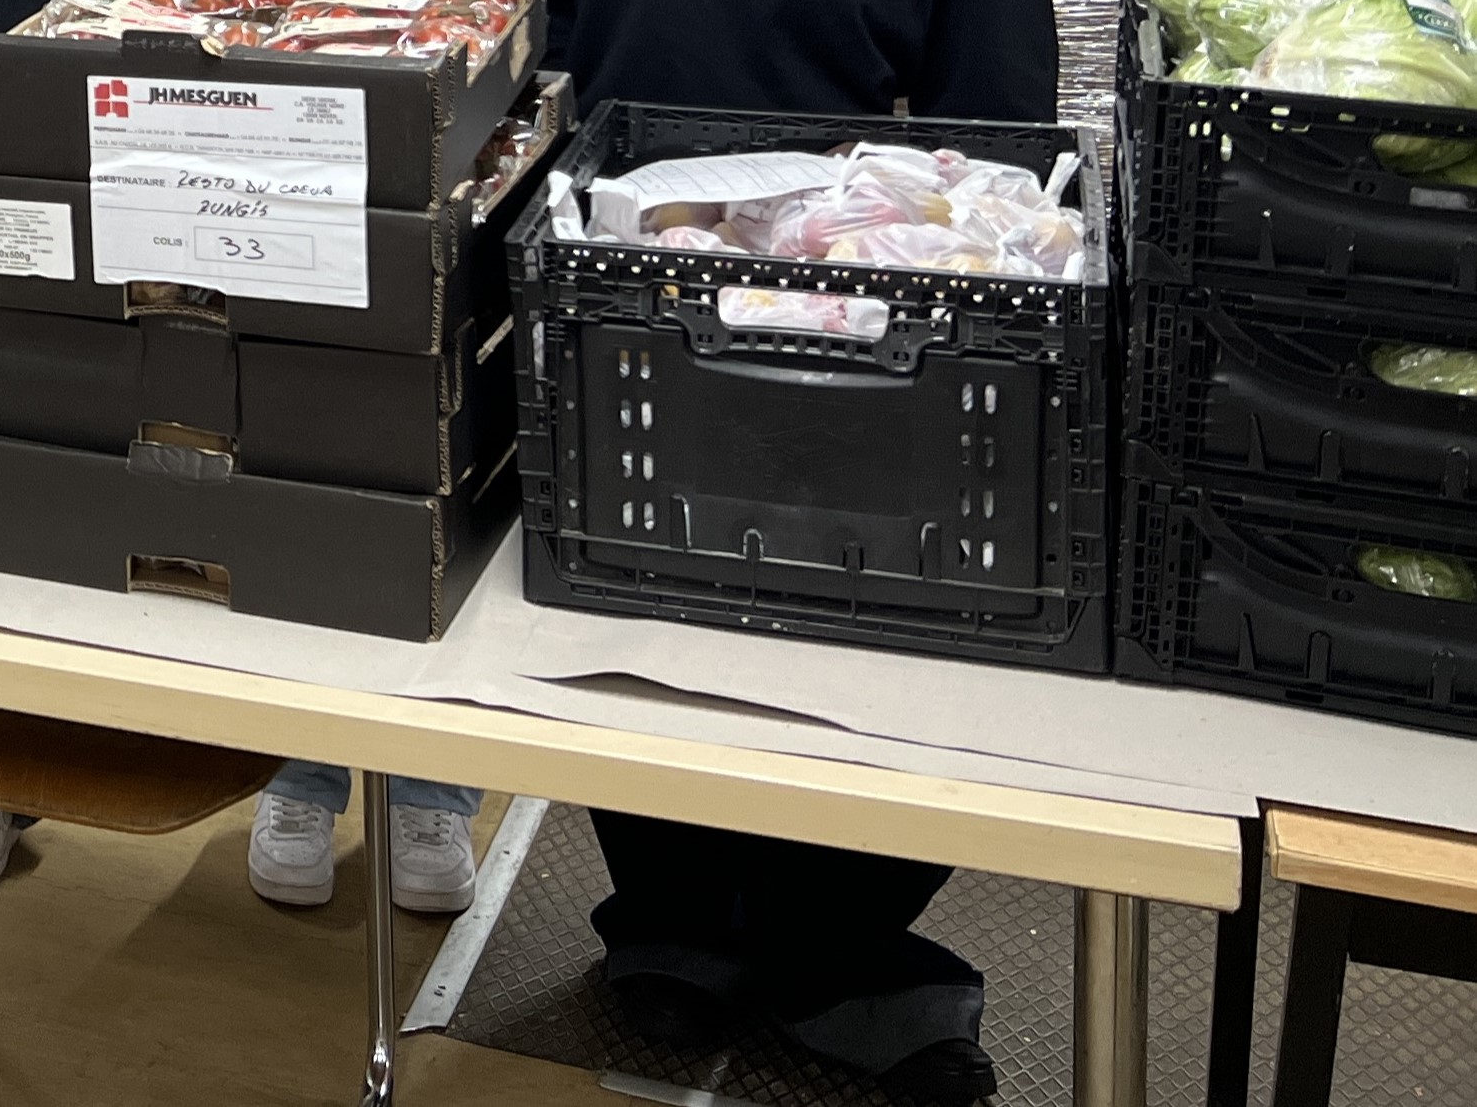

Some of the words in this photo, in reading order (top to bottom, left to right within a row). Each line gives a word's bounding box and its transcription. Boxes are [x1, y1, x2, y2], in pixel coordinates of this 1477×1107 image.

[95, 174, 166, 188] DESTINATAIRE
[245, 179, 272, 194] DU
[152, 236, 183, 247] COLIS
